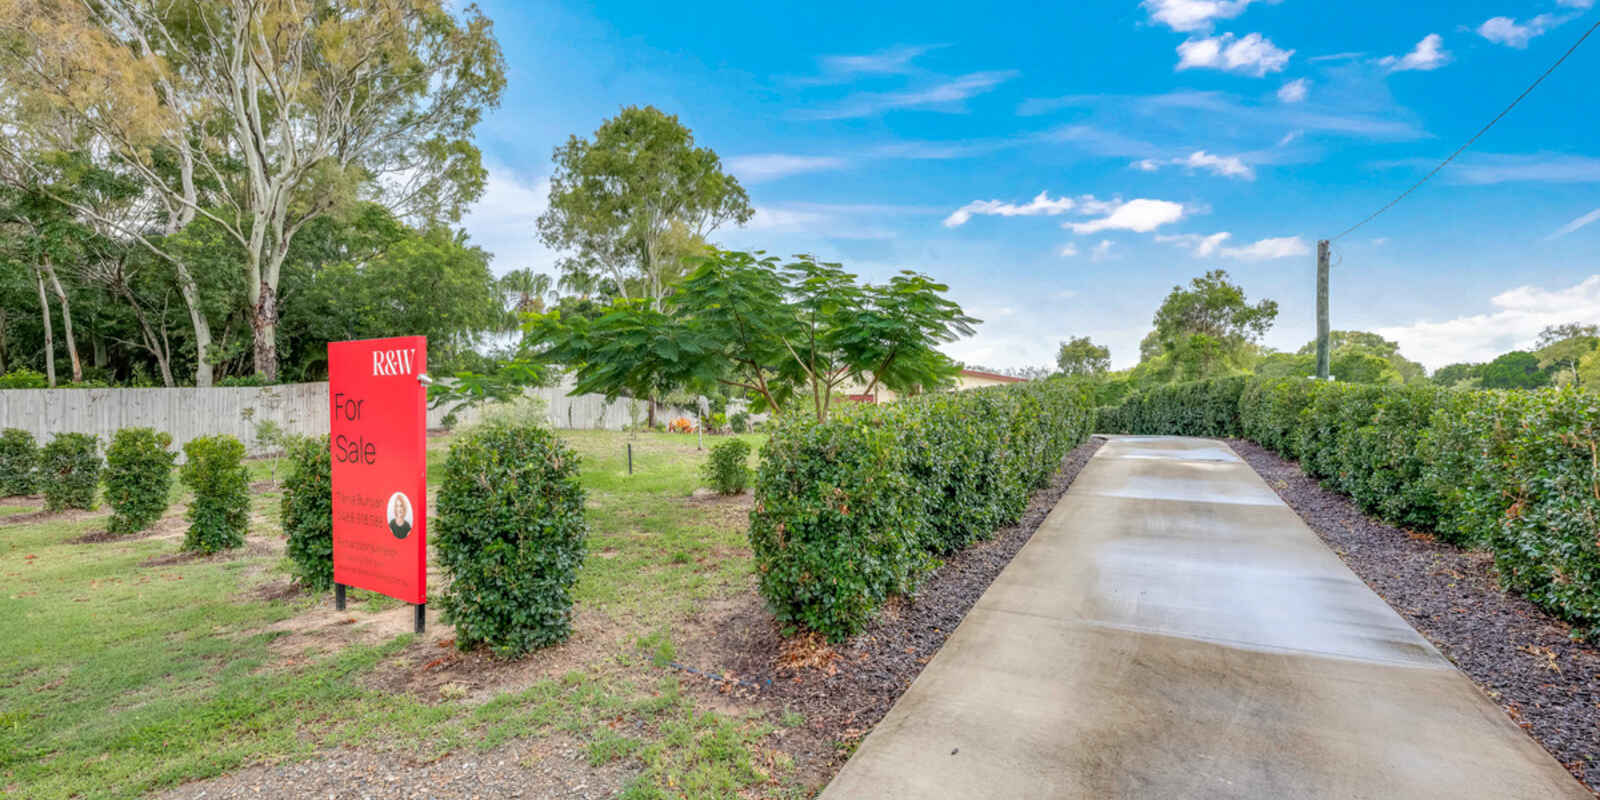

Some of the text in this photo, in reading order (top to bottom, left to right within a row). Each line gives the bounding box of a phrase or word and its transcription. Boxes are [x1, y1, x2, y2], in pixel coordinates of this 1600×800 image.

[372, 349, 415, 376] R&W
[335, 392, 364, 421] For
[335, 434, 376, 465] Sale
